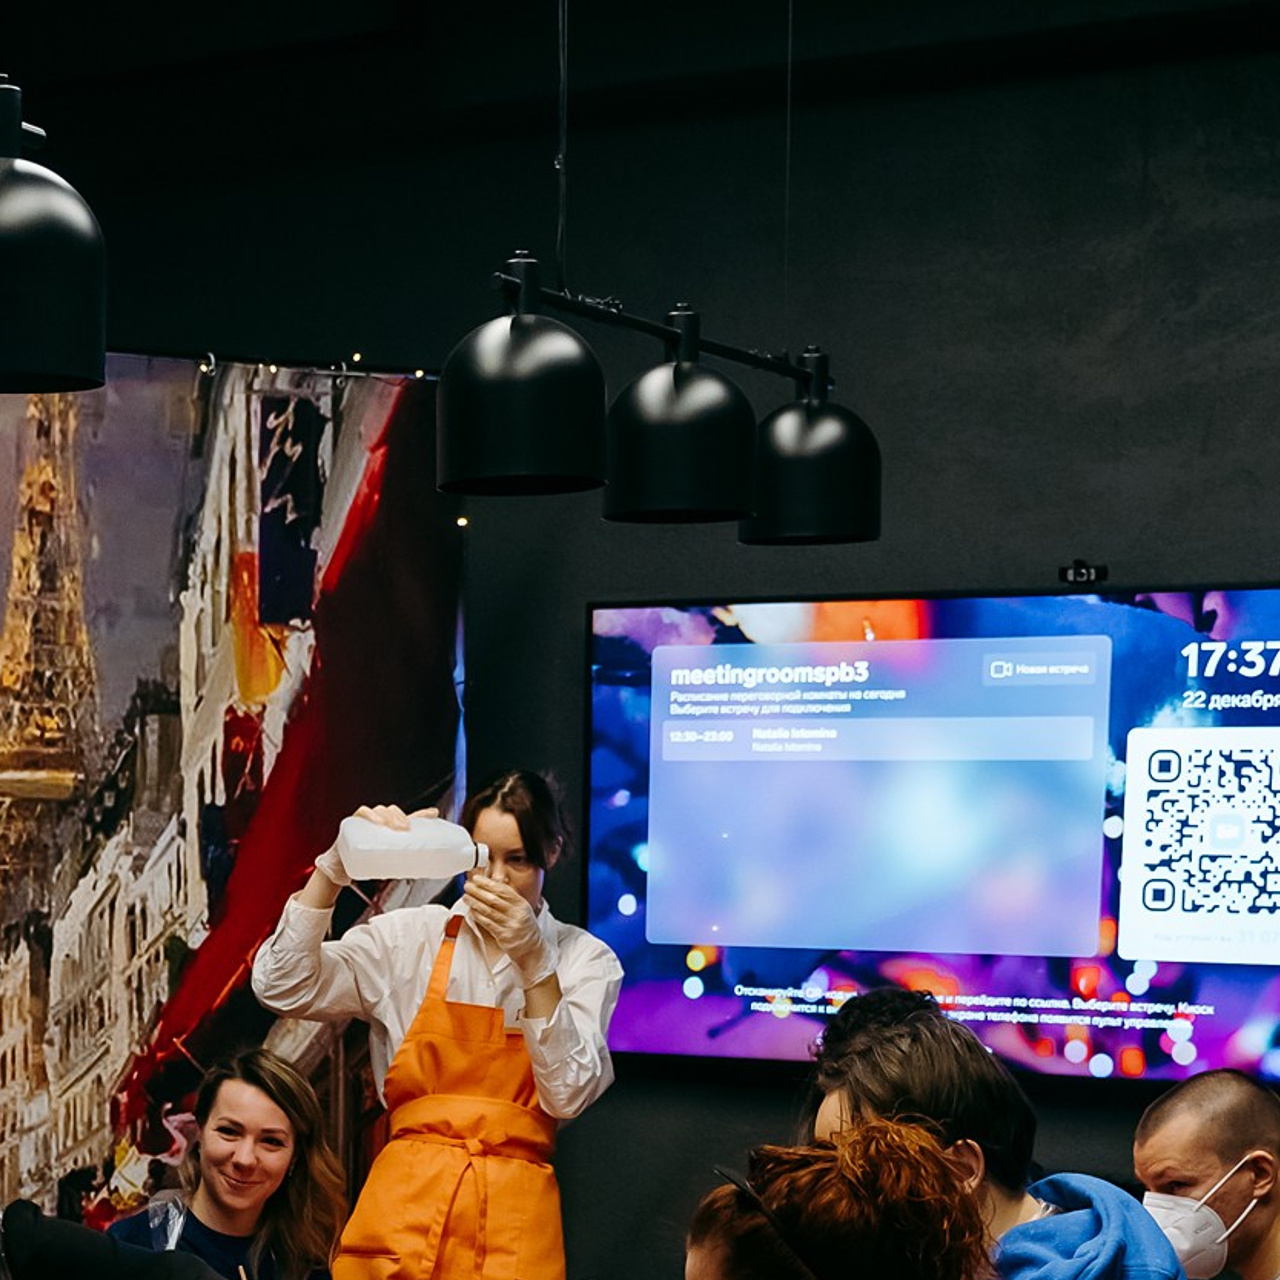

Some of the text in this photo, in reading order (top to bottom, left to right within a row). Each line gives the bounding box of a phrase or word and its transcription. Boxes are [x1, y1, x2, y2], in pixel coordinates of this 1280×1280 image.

[1181, 641, 1280, 677] 17:37
[671, 661, 868, 687] meetingroomspb3
[670, 690, 729, 702] Расписание
[730, 690, 801, 703] переговорной
[848, 690, 863, 700] на
[863, 689, 907, 701] сегодня
[1182, 691, 1206, 708] 22
[670, 704, 719, 716] Выберите
[720, 703, 759, 716] встречу
[760, 704, 781, 715] для
